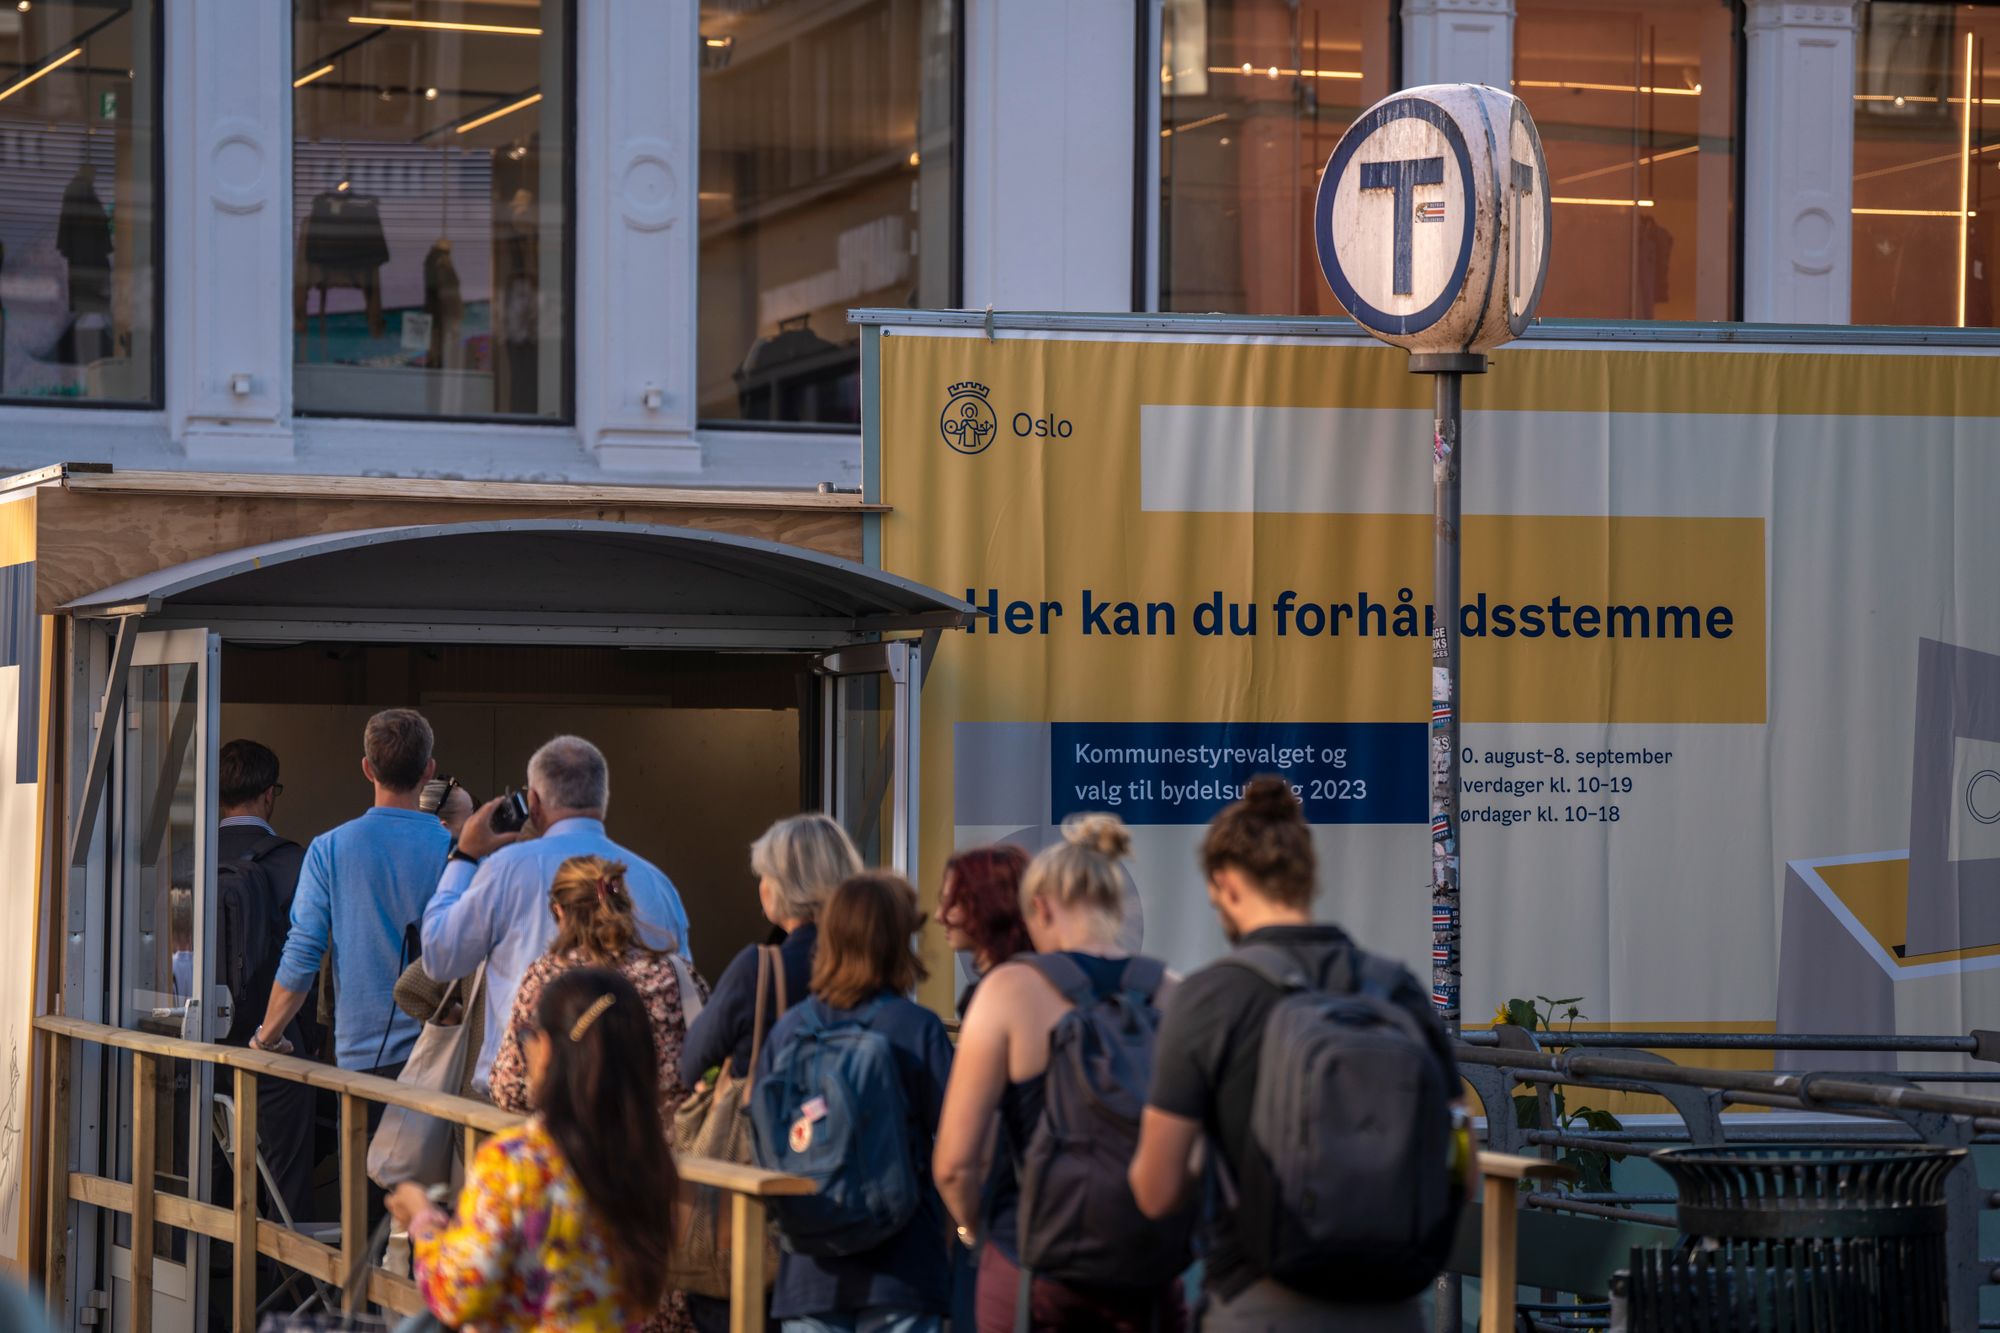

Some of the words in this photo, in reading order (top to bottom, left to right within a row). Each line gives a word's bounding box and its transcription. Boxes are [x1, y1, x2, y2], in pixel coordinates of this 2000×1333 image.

[1360, 157, 1443, 295] T
[1012, 412, 1073, 438] Oslo
[963, 588, 1063, 635] Her
[1082, 589, 1176, 636] kan
[1193, 591, 1257, 636] du
[1075, 743, 1315, 769] Kommunestyrevalget
[1321, 748, 1347, 769] og
[1461, 747, 1479, 764] 0.
[1575, 747, 1673, 768] september
[1074, 780, 1122, 805] valg
[1128, 779, 1154, 800] til
[1310, 779, 1367, 800] 2023
[1459, 776, 1545, 798] verdager
[1550, 776, 1571, 793] kl.
[1578, 776, 1633, 793] 10–19
[1460, 805, 1532, 827] ørdager
[1537, 805, 1558, 822] kl.
[1565, 805, 1620, 822] 10–18
